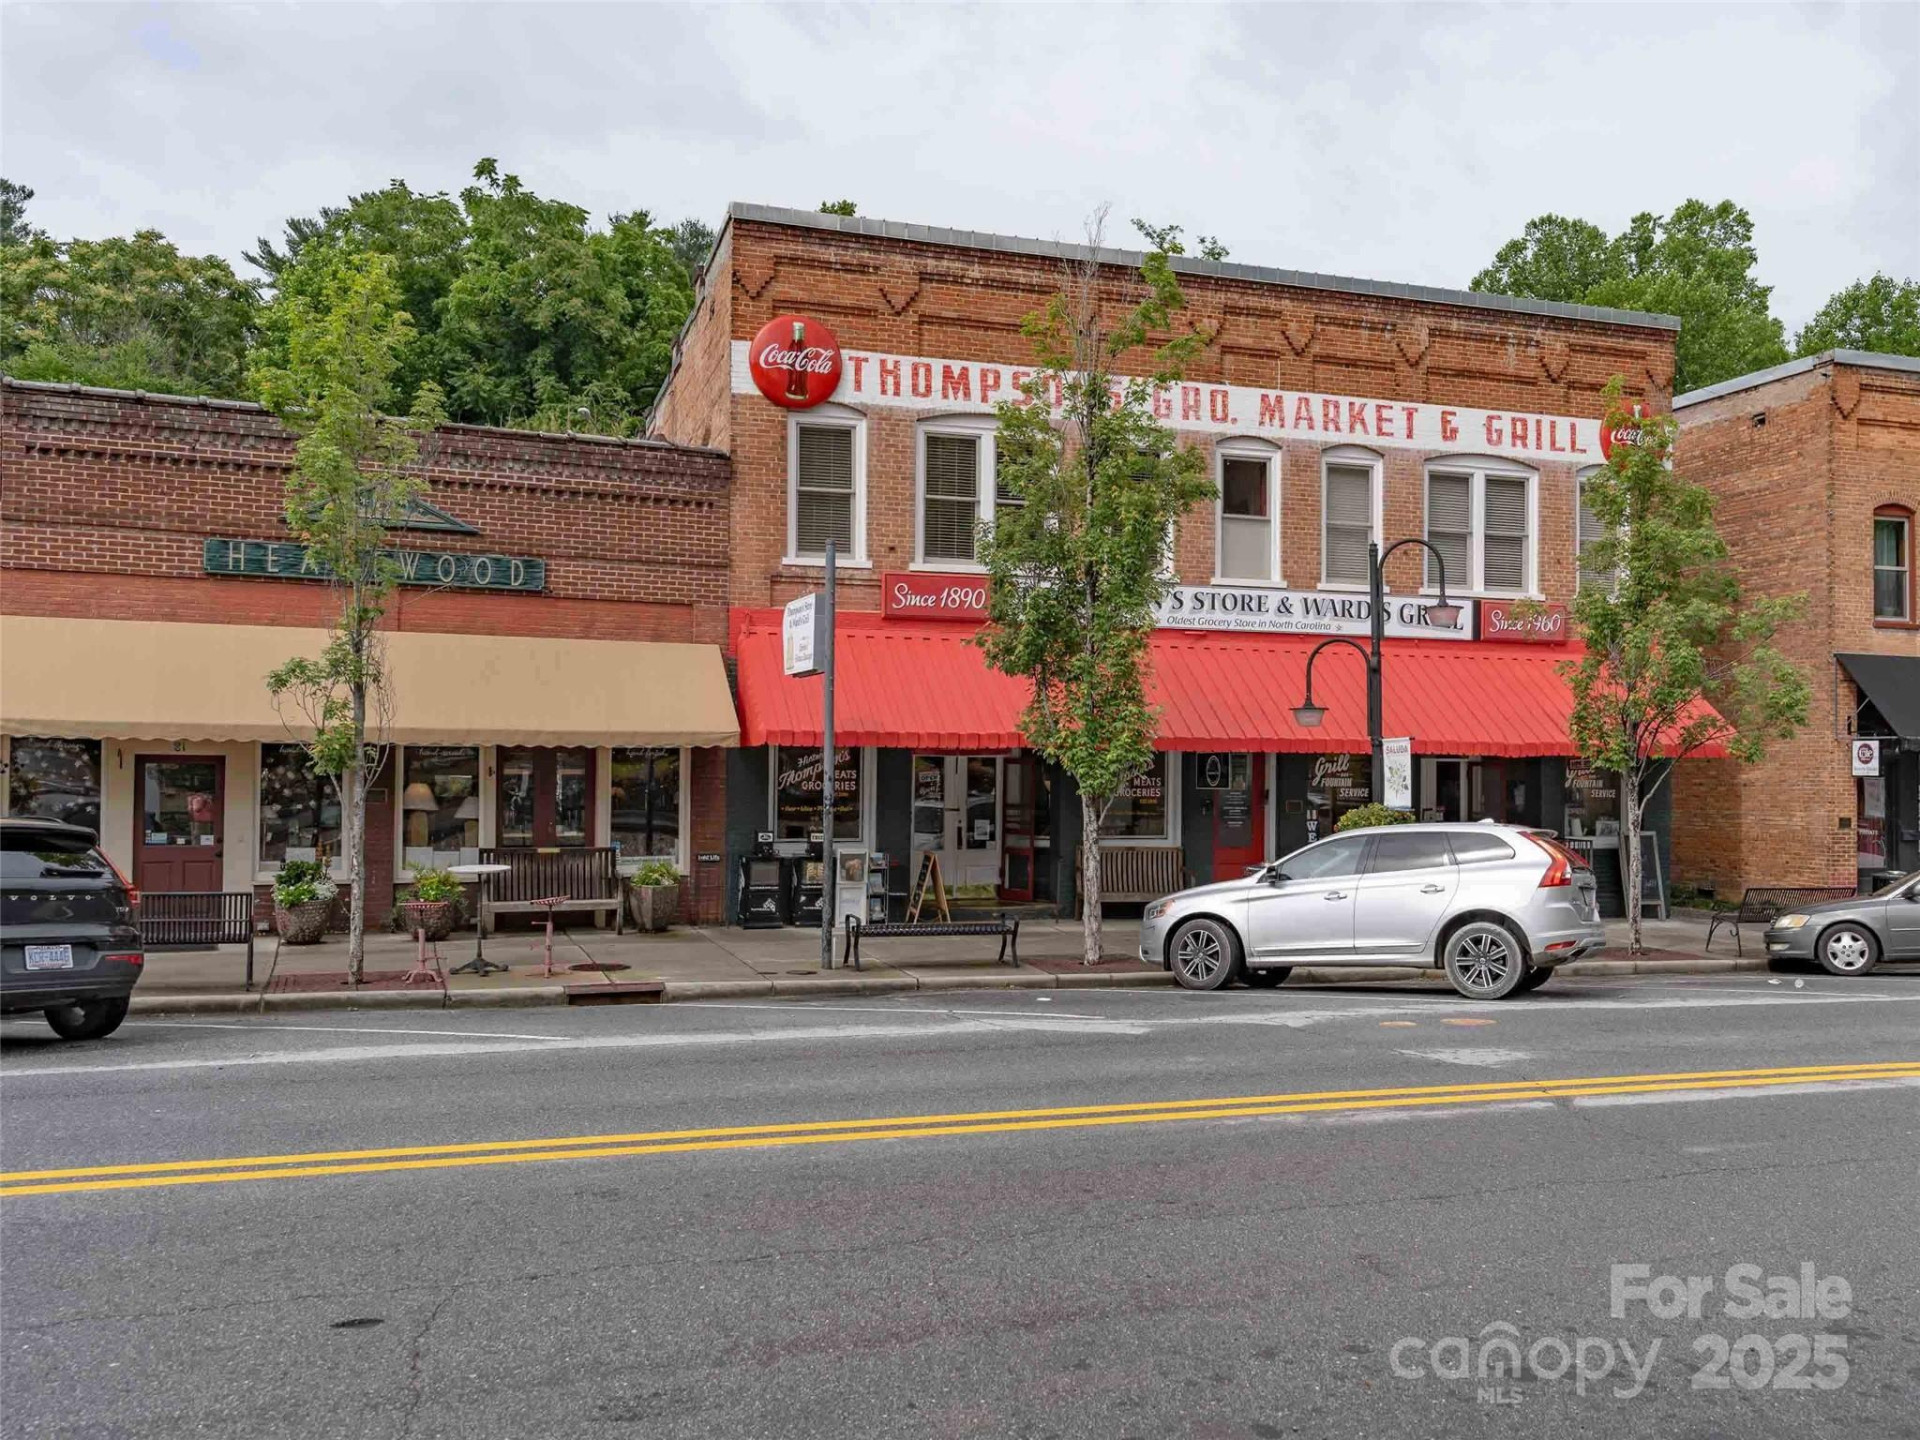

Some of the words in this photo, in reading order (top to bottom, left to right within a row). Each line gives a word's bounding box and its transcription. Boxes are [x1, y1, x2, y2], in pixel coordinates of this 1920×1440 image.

[759, 343, 836, 375] Coca-Cola
[848, 356, 1123, 412] THOMPSOS
[1153, 382, 1238, 425] GRO.
[1258, 393, 1419, 440] MARKET
[1441, 410, 1459, 442] &
[1485, 414, 1588, 454] GRILL
[228, 541, 524, 586] HEAWOOD
[892, 583, 937, 609] Since
[940, 587, 986, 609] 1890
[1193, 591, 1269, 613] STORE
[1277, 596, 1294, 614] &
[1302, 597, 1391, 622] WARDS
[1167, 616, 1197, 626] Oldest
[1198, 617, 1232, 629] Grocery
[1234, 619, 1257, 628] Store
[1258, 620, 1267, 629] in
[1269, 620, 1293, 630] North
[1295, 621, 1331, 632] Carolina
[1489, 609, 1523, 632] Since
[1385, 745, 1409, 755] SALUDA
[1312, 753, 1350, 787] Grill
[1133, 777, 1162, 787] MEATS
[1320, 778, 1353, 788] FOUNTAIN
[1572, 779, 1604, 788] FOUNTAIN
[1340, 788, 1369, 798] SERVICE
[1591, 789, 1617, 799] SERVICE
